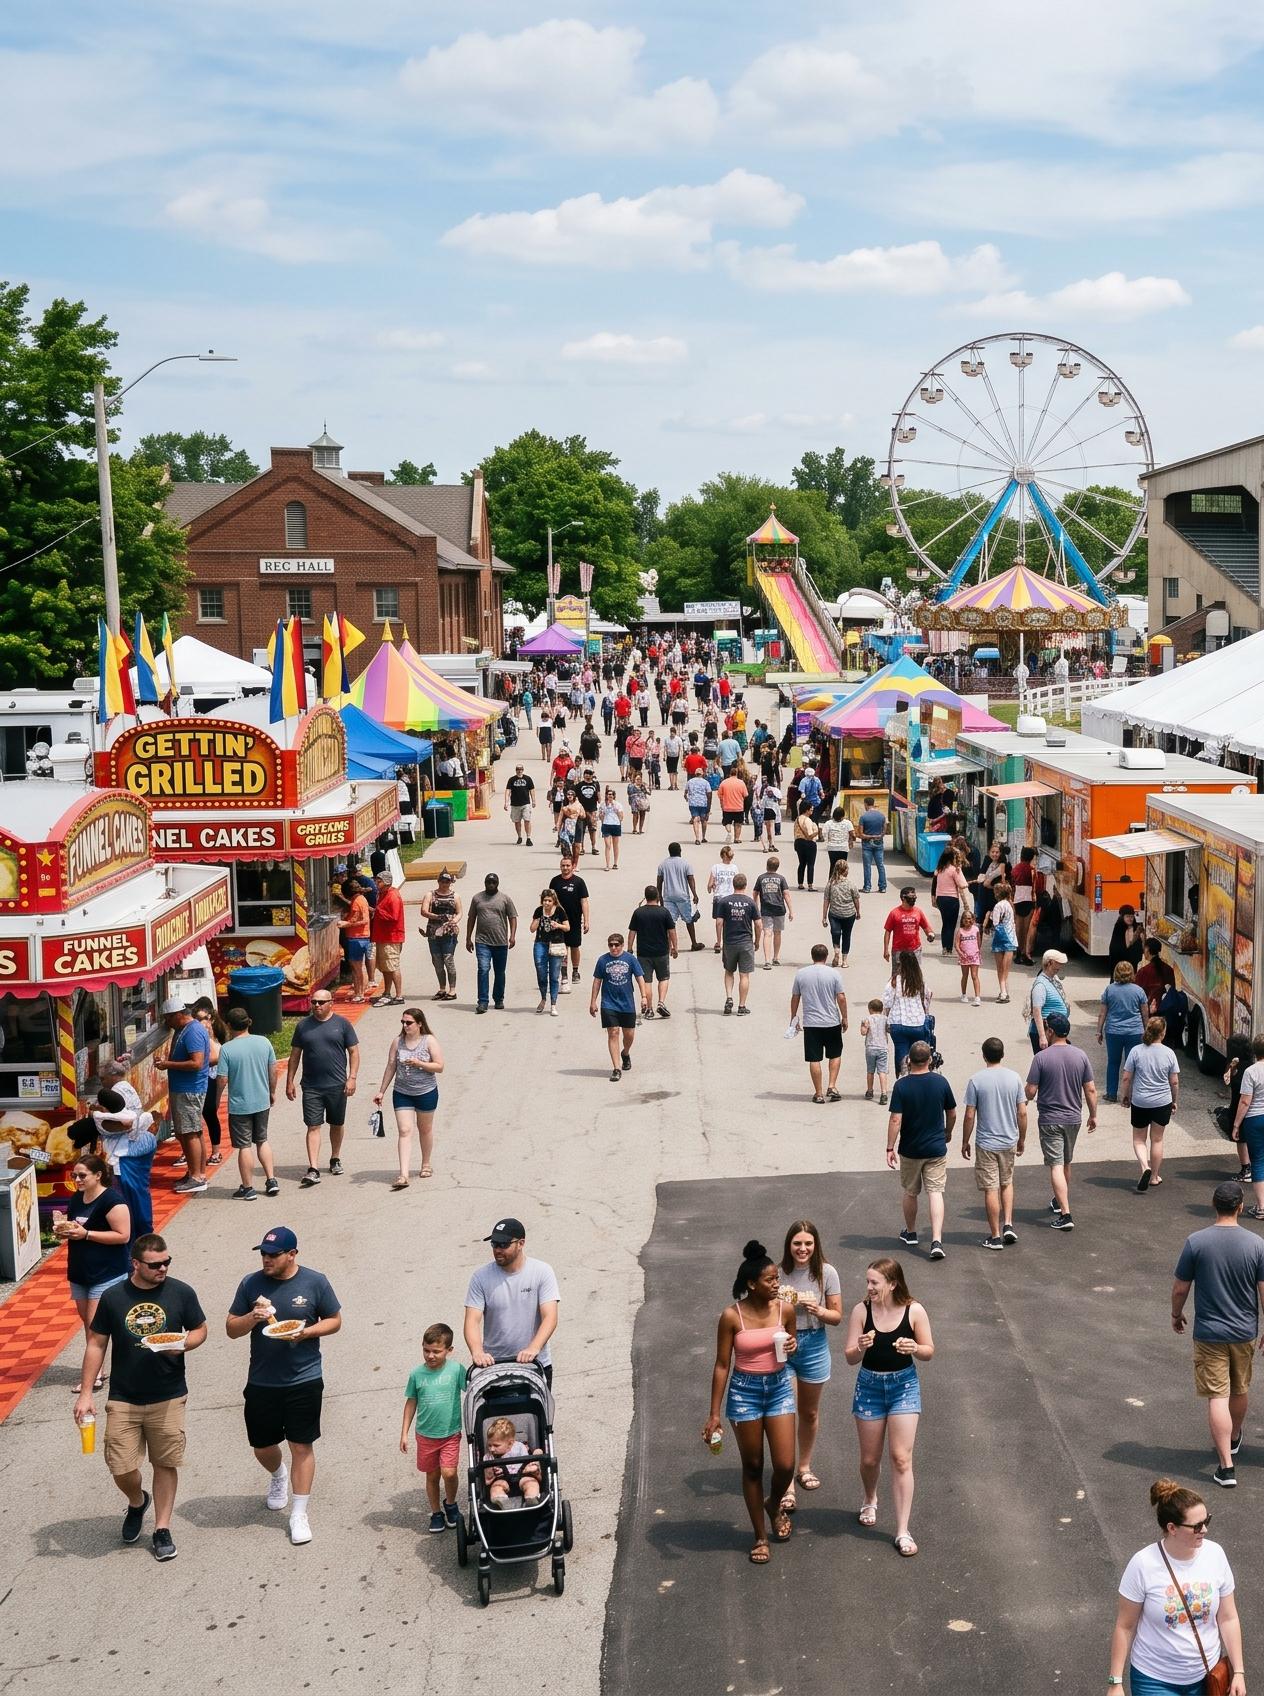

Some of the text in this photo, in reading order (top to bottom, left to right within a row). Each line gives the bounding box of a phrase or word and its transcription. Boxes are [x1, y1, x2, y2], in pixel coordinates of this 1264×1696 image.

[264, 561, 331, 571] REC HALL
[135, 732, 254, 759] GETTIN'
[126, 761, 265, 795] GRILLED
[69, 813, 144, 884] FUNNEL CAKES
[199, 827, 276, 848] CAKES
[63, 933, 131, 954] FUNNEL
[54, 946, 139, 974] CAKES
